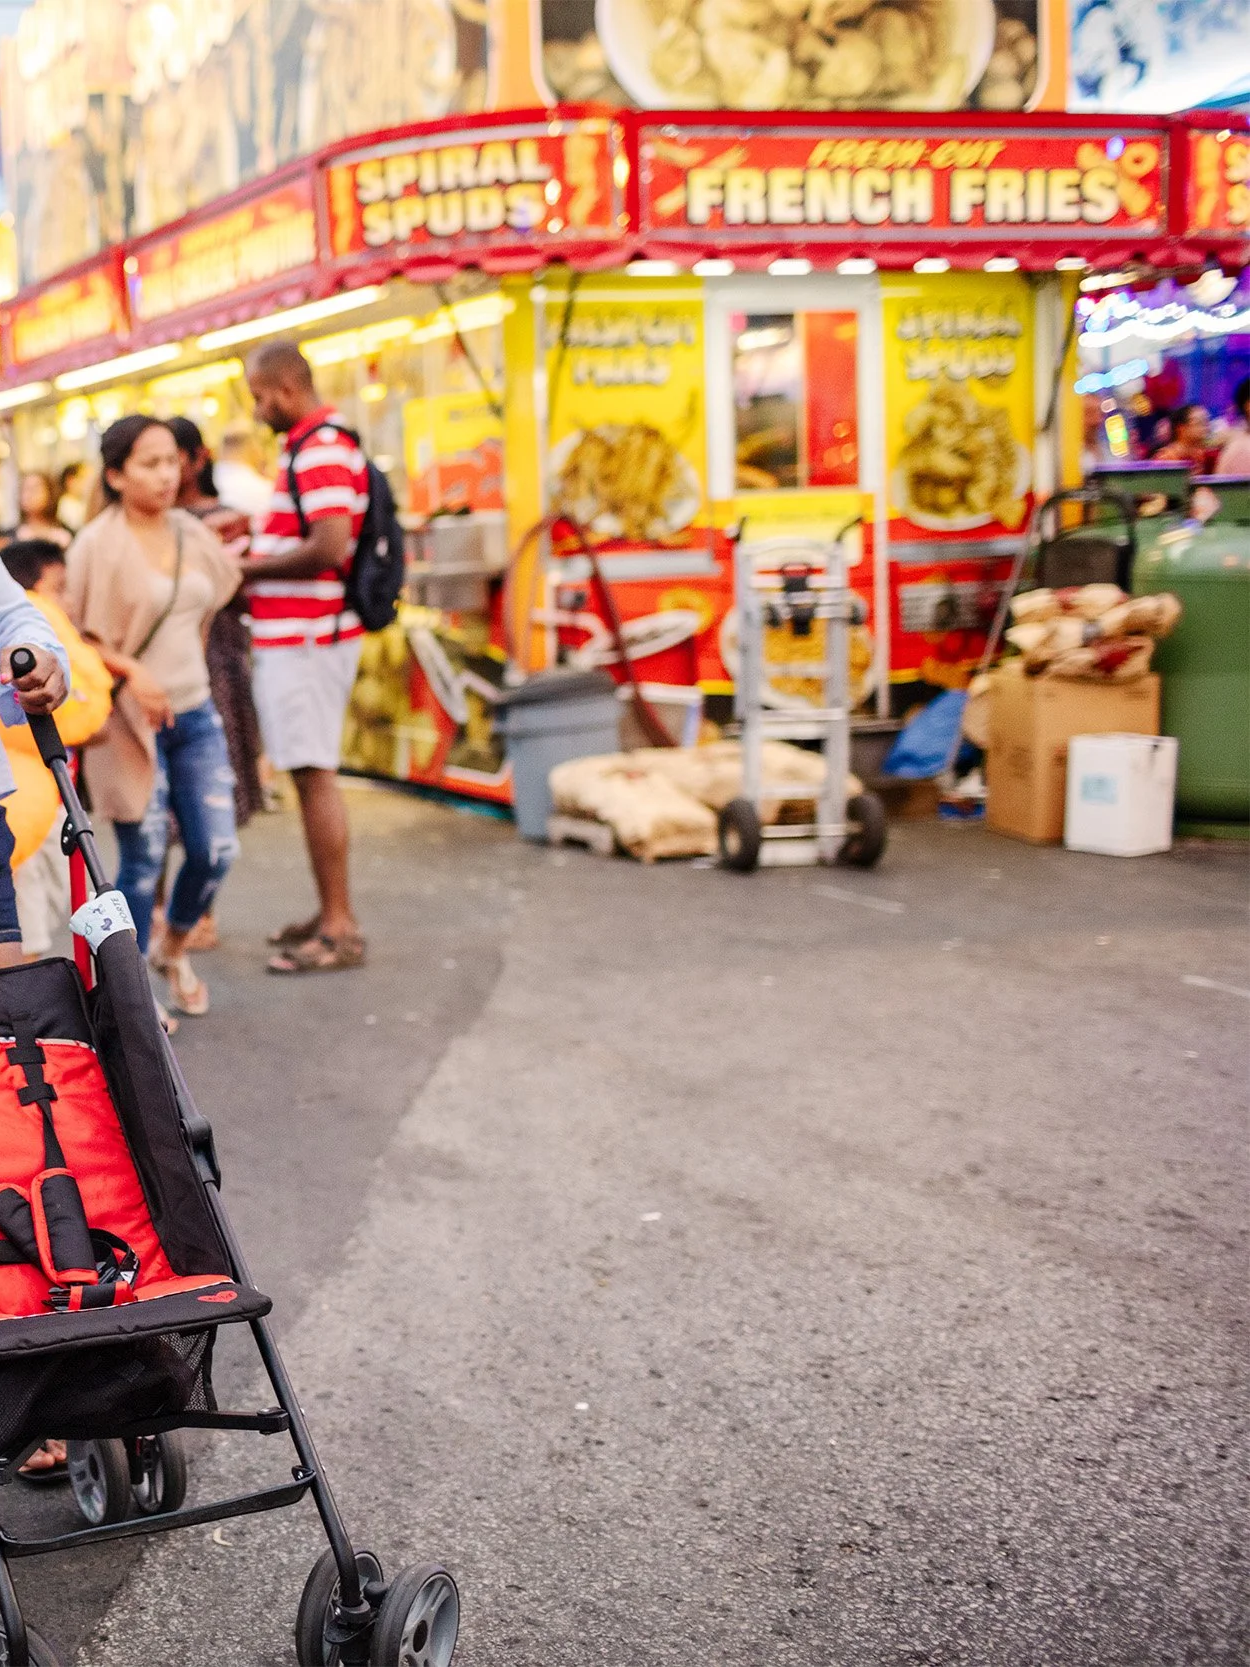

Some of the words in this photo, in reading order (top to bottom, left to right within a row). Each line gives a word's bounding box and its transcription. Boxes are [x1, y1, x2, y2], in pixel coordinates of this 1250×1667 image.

[356, 138, 552, 205] SPIRAL
[685, 166, 933, 225] FRENCH
[952, 166, 1120, 224] FRIES
[362, 182, 547, 247] SPUDS
